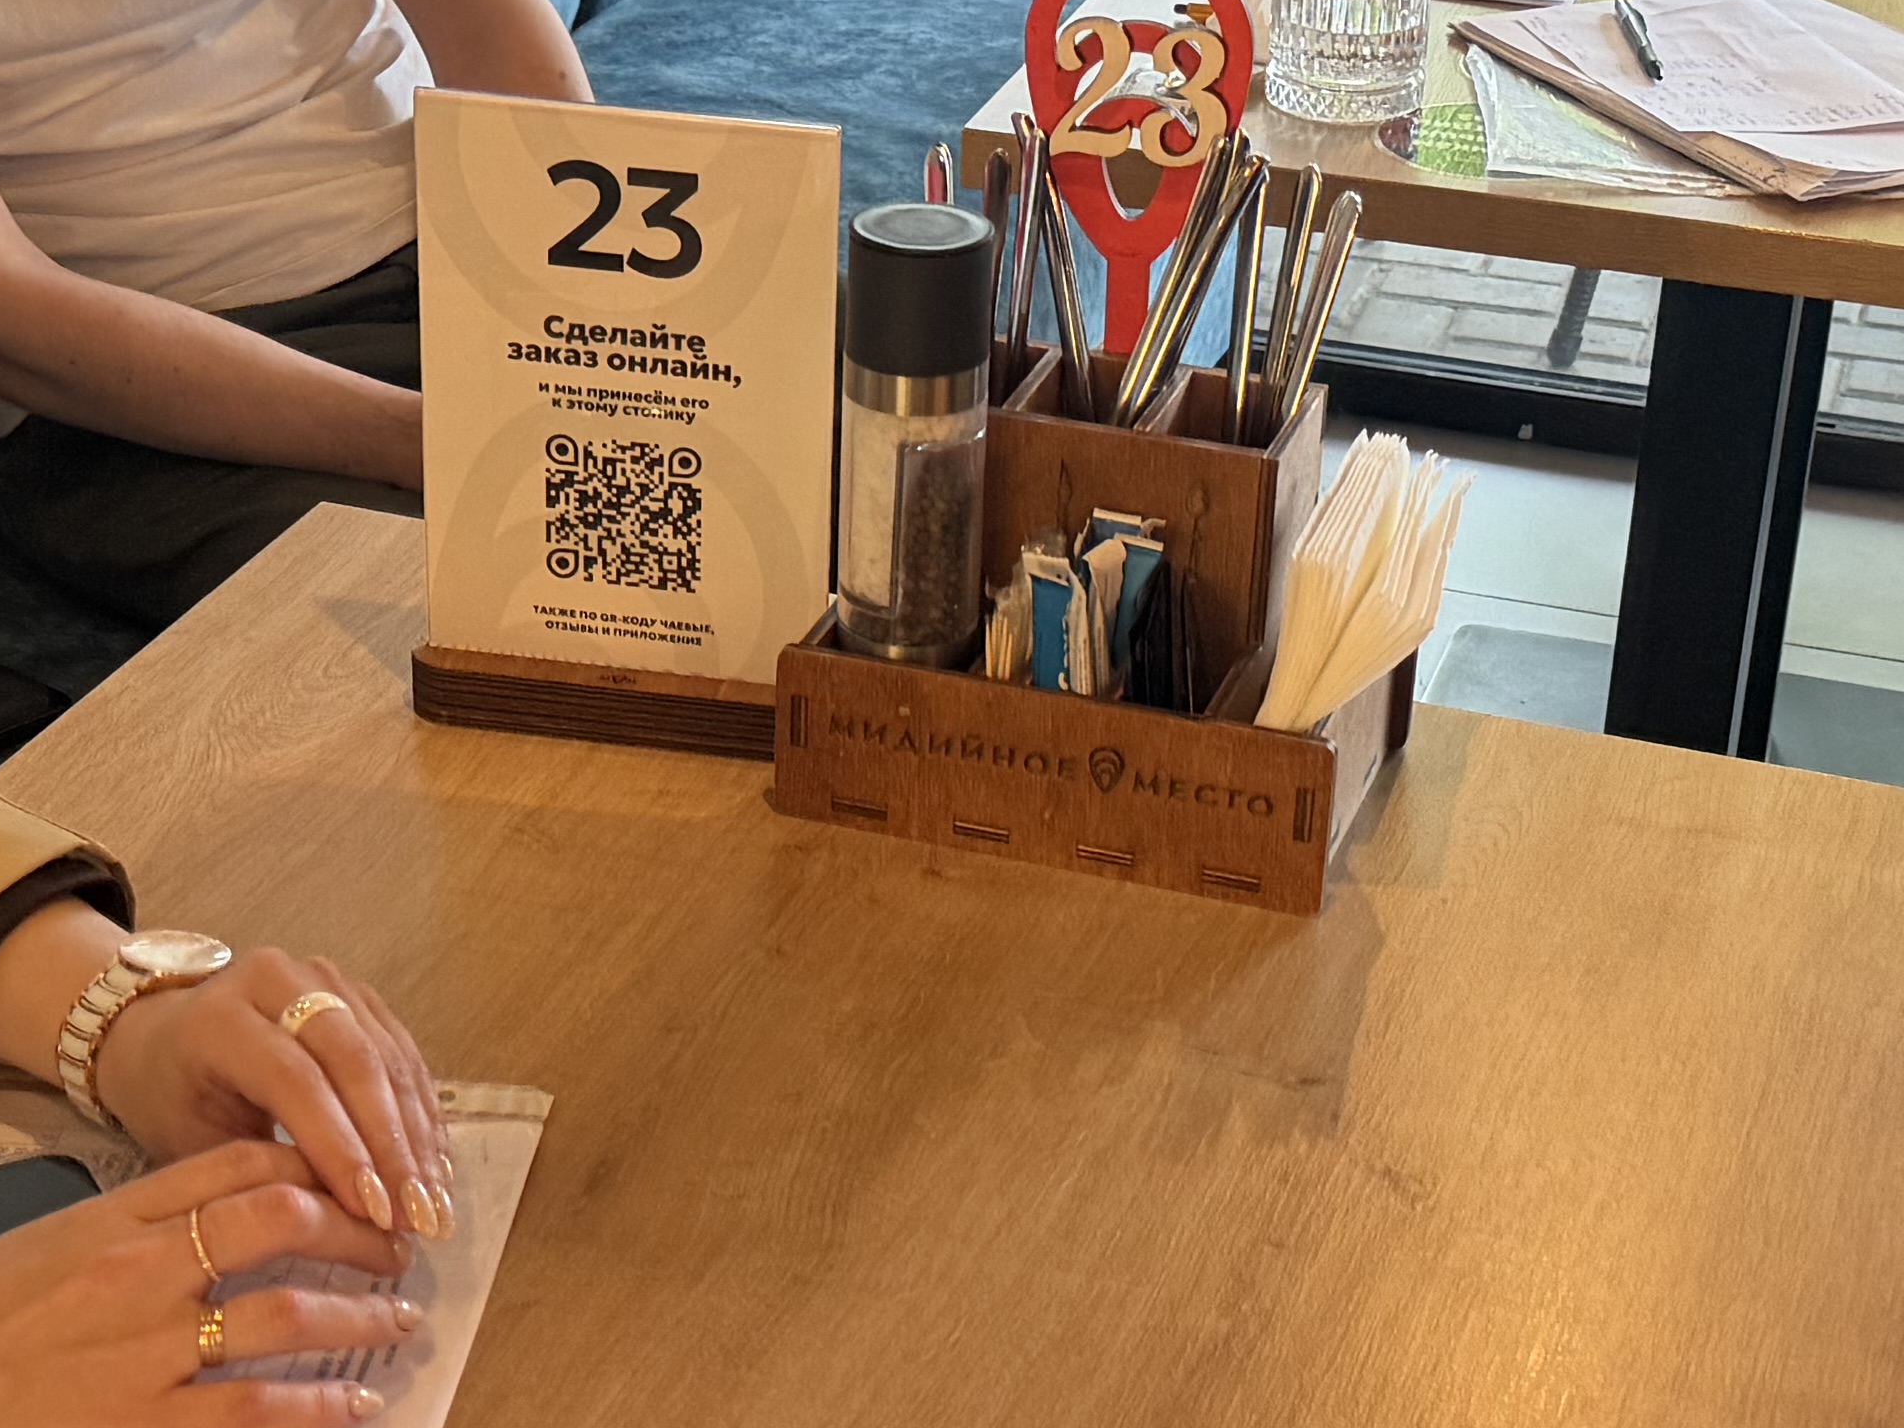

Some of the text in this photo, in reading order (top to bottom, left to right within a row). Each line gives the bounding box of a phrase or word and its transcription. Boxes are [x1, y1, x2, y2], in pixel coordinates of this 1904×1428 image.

[1049, 17, 1227, 167] 23
[547, 160, 702, 279] 23
[543, 315, 706, 353] Сделайте
[507, 342, 742, 388] заказ онлайн,
[539, 382, 709, 410] и мы принесём его
[552, 397, 562, 408] к
[566, 399, 618, 417] этому
[533, 605, 715, 636] ТАКЖЕ ПО QR-КОДУ ЧАЕВЫЕ,
[545, 620, 703, 647] ОТЗЫВЫ И ПРИЛОЖЕНИЕ
[827, 714, 1274, 817] МИДИЙНОЕ МЕСТО
